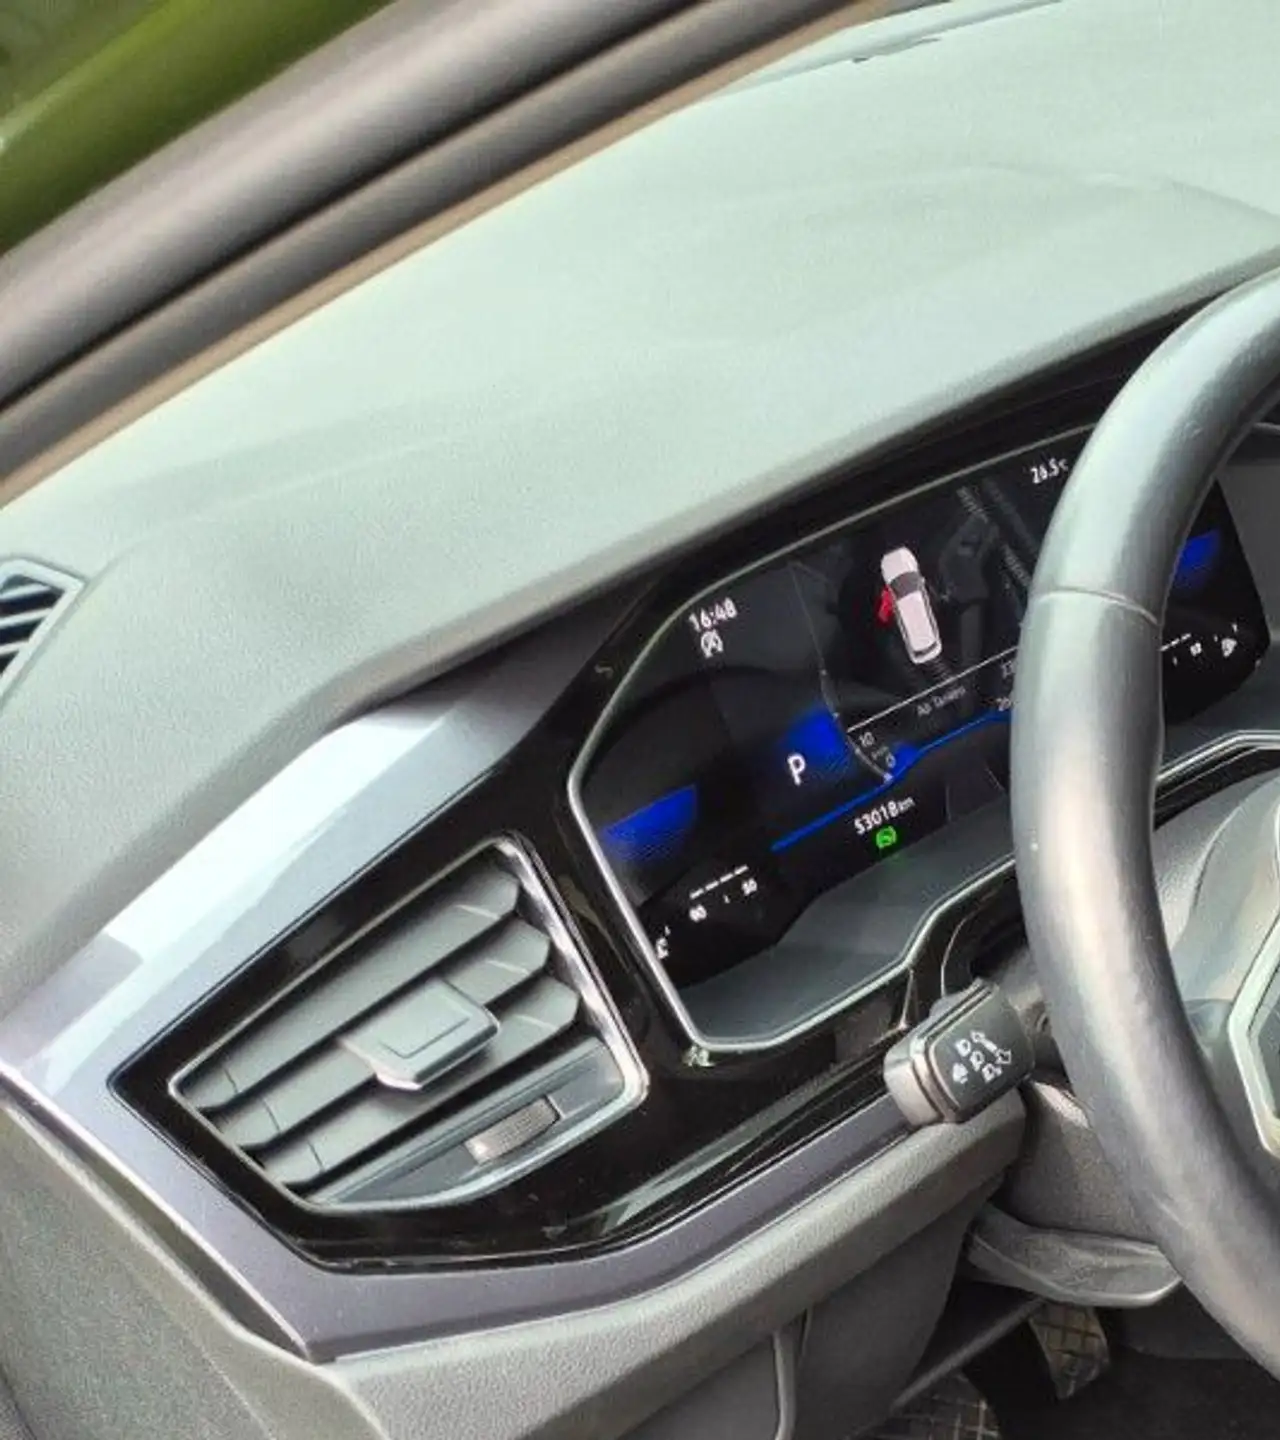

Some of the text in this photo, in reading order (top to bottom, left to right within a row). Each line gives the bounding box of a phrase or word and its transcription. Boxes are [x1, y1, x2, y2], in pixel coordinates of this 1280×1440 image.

[689, 597, 738, 632] 16:48
[787, 754, 807, 786] P
[854, 801, 899, 835] 53018
